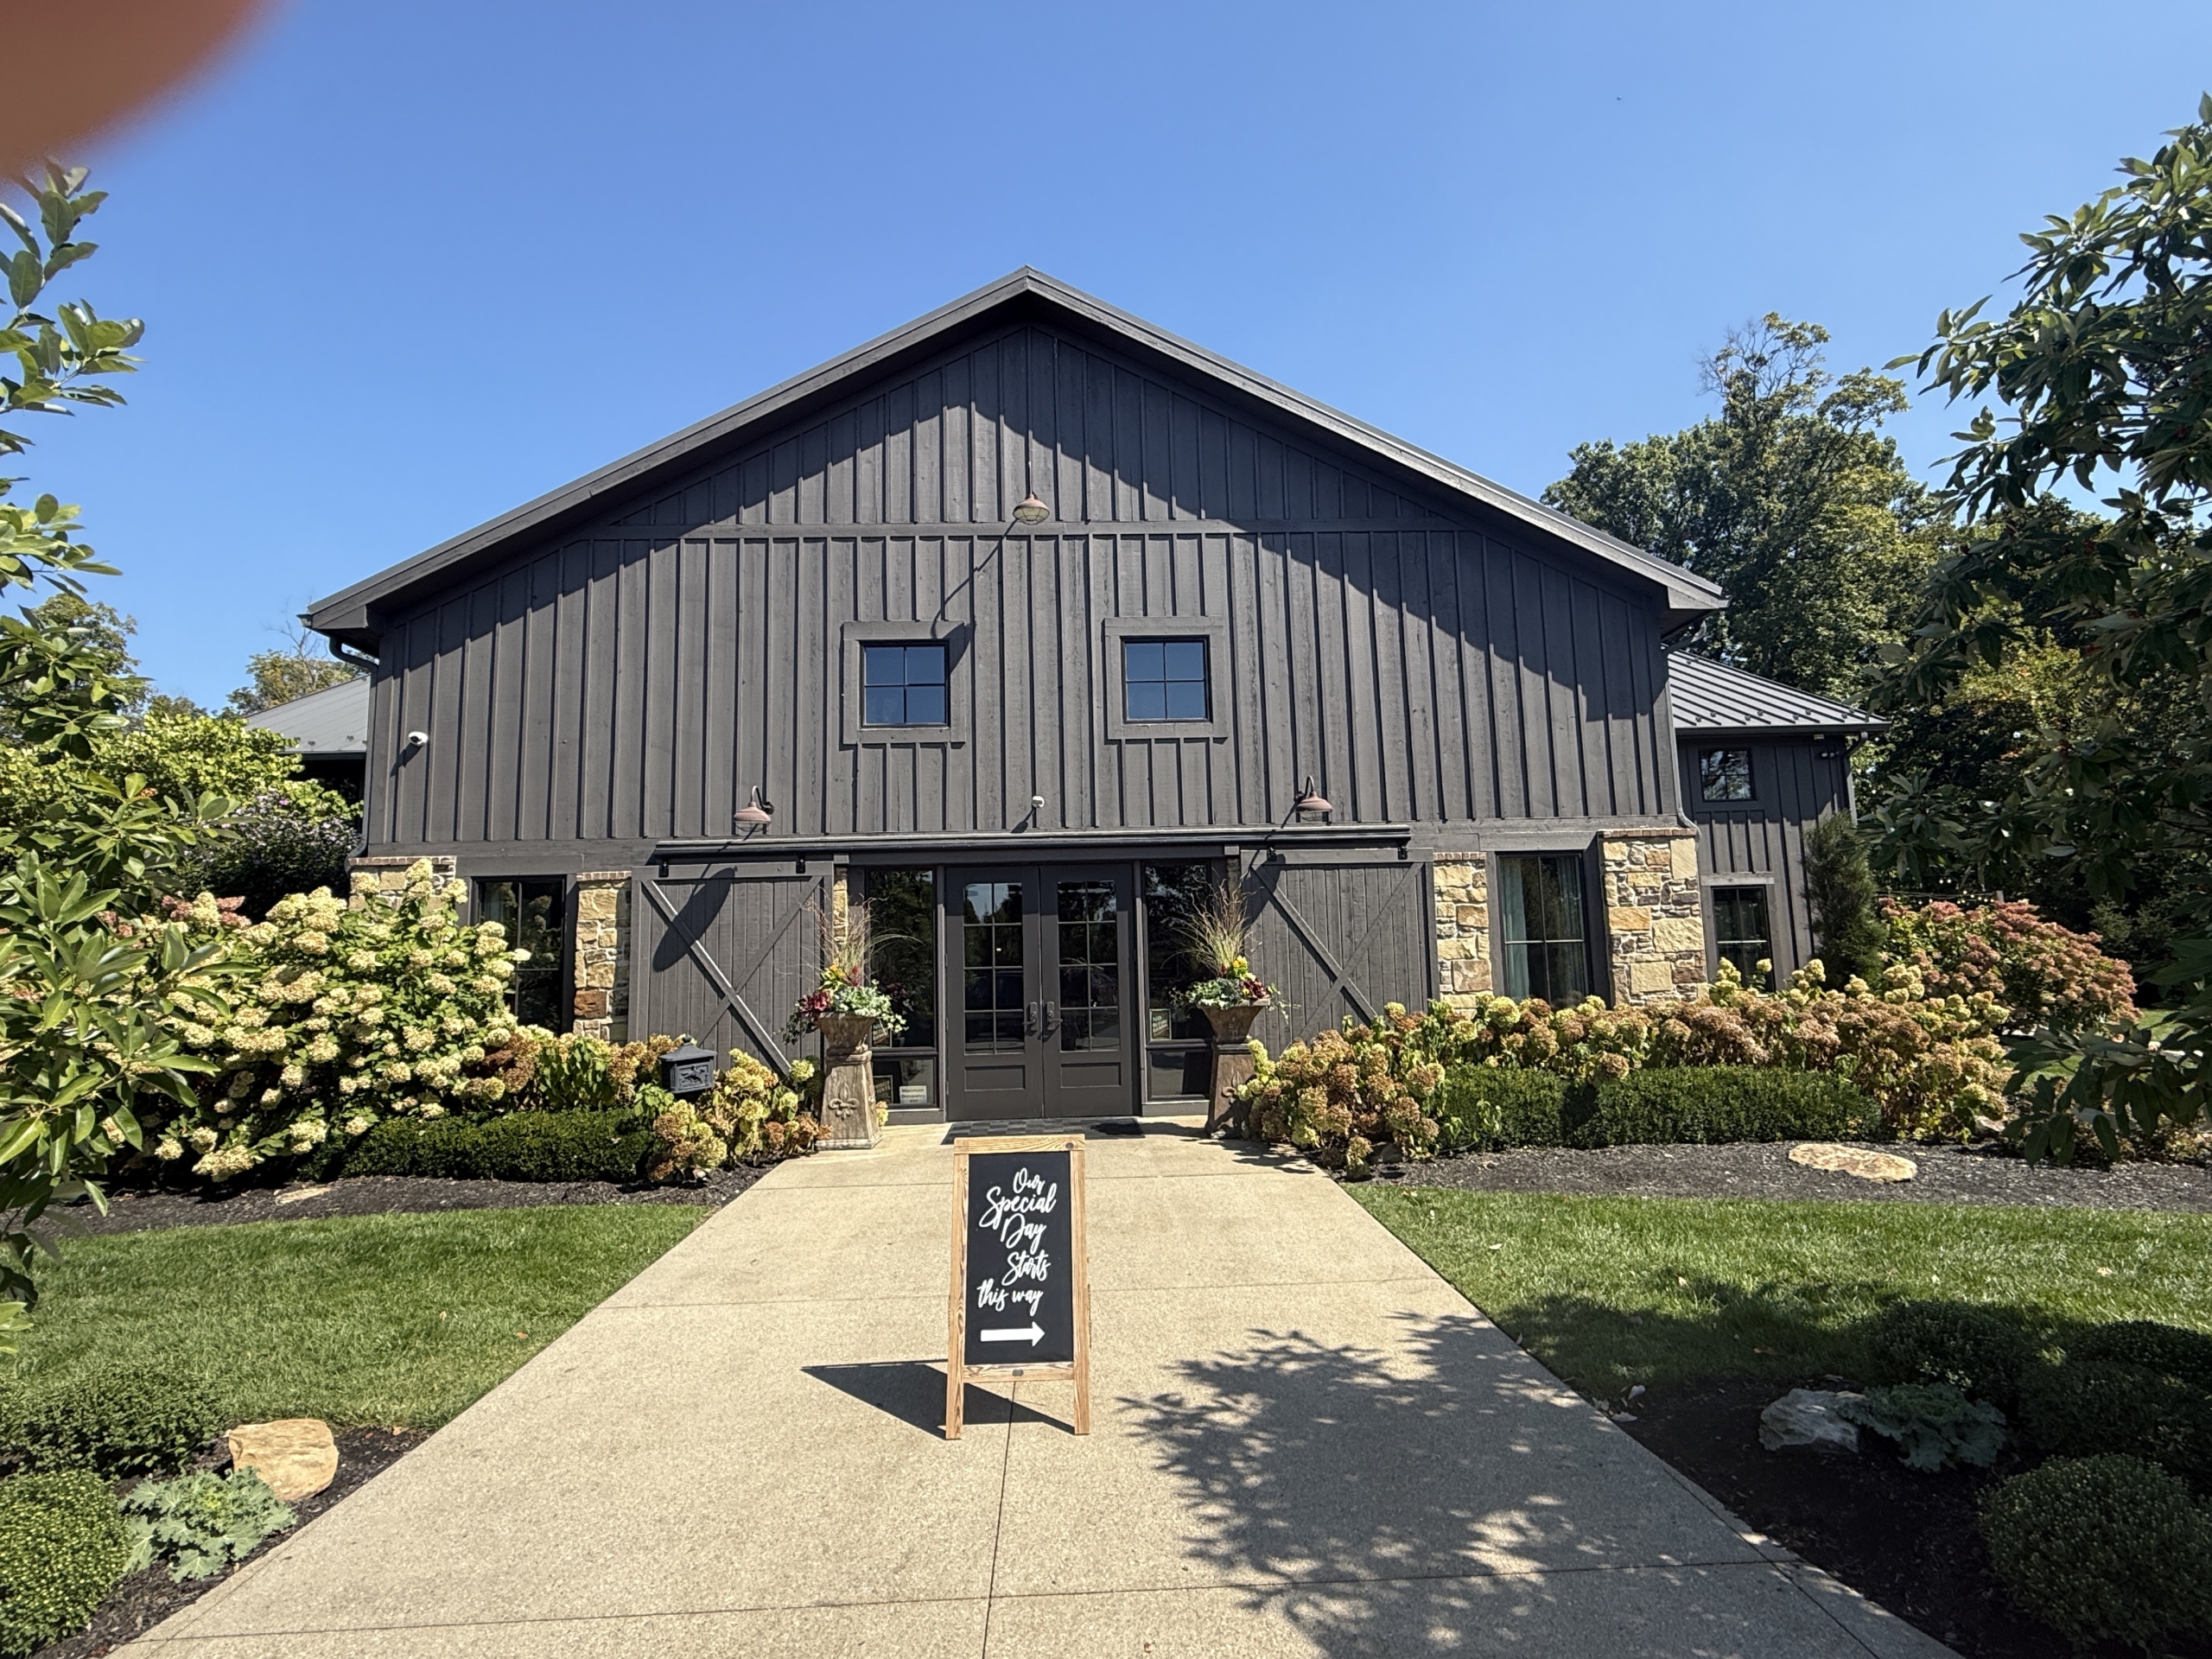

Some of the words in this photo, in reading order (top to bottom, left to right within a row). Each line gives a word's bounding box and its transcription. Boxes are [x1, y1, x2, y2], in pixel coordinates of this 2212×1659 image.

[1013, 1167, 1046, 1195] Our
[978, 1183, 1058, 1230] Special
[1000, 1213, 1046, 1255] Day
[1001, 1249, 1052, 1286] Starts
[976, 1278, 1009, 1312] this
[1012, 1289, 1044, 1317] way
